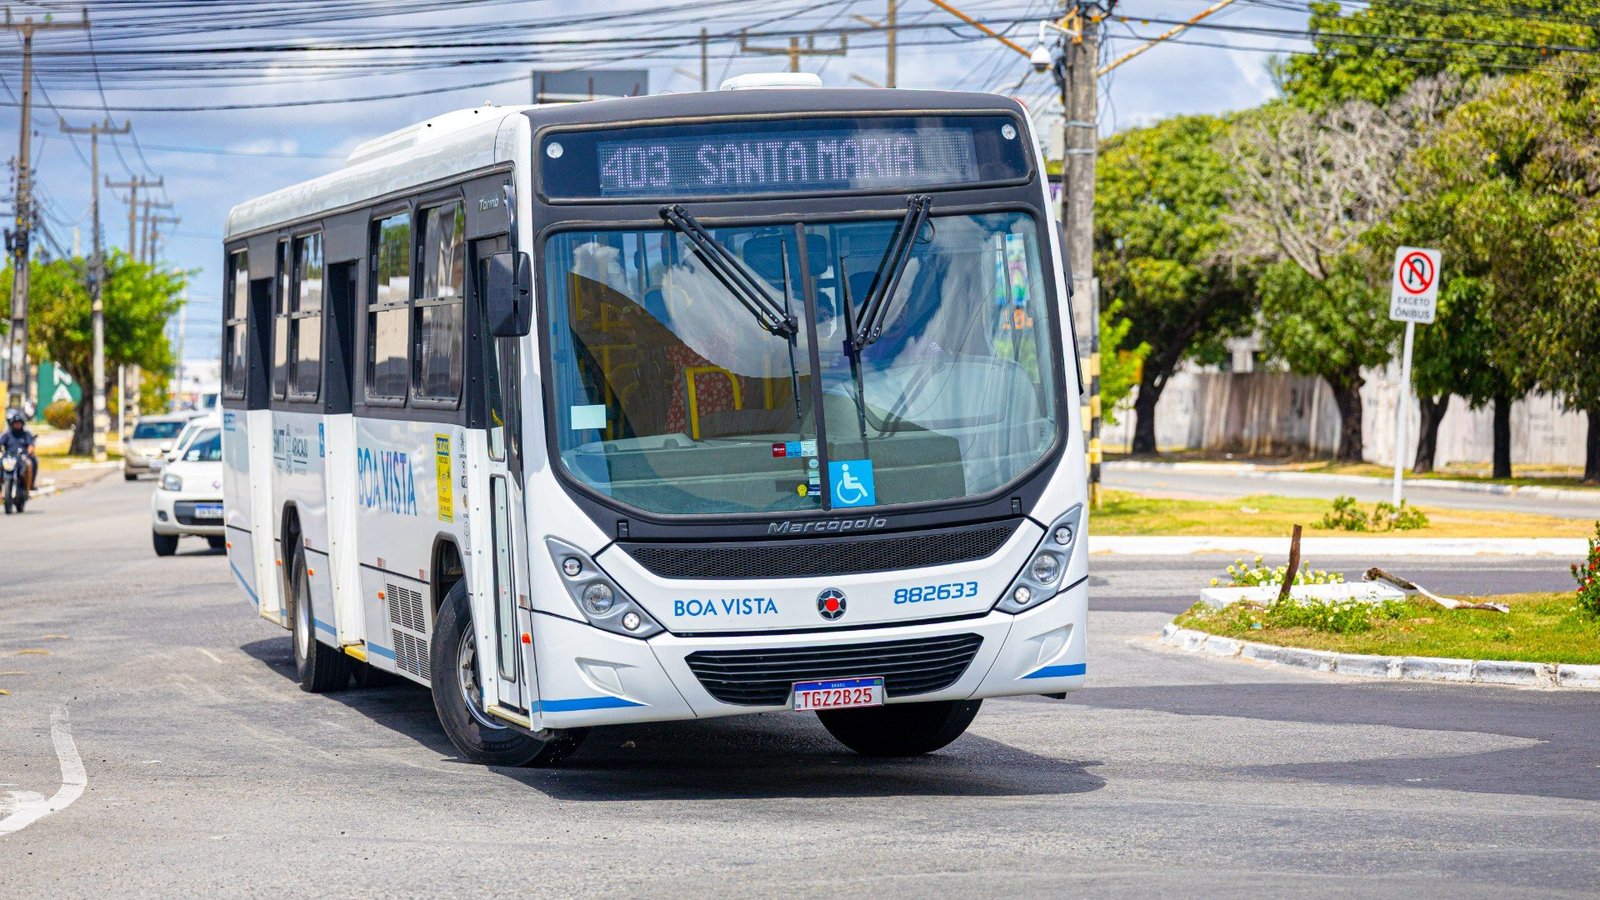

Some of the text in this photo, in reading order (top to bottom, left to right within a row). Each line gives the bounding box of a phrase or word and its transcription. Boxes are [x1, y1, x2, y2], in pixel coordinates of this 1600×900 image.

[602, 137, 915, 188] 403 SANTA MARIA
[1397, 297, 1430, 306] EXCETO
[1394, 306, 1430, 319] ÔNIBUS
[357, 447, 418, 516] BOA VISTA
[767, 516, 887, 535] Marcopolo
[893, 581, 979, 605] 882633
[674, 597, 778, 617] BOA VISTA
[802, 688, 872, 707] TGZ2B25
